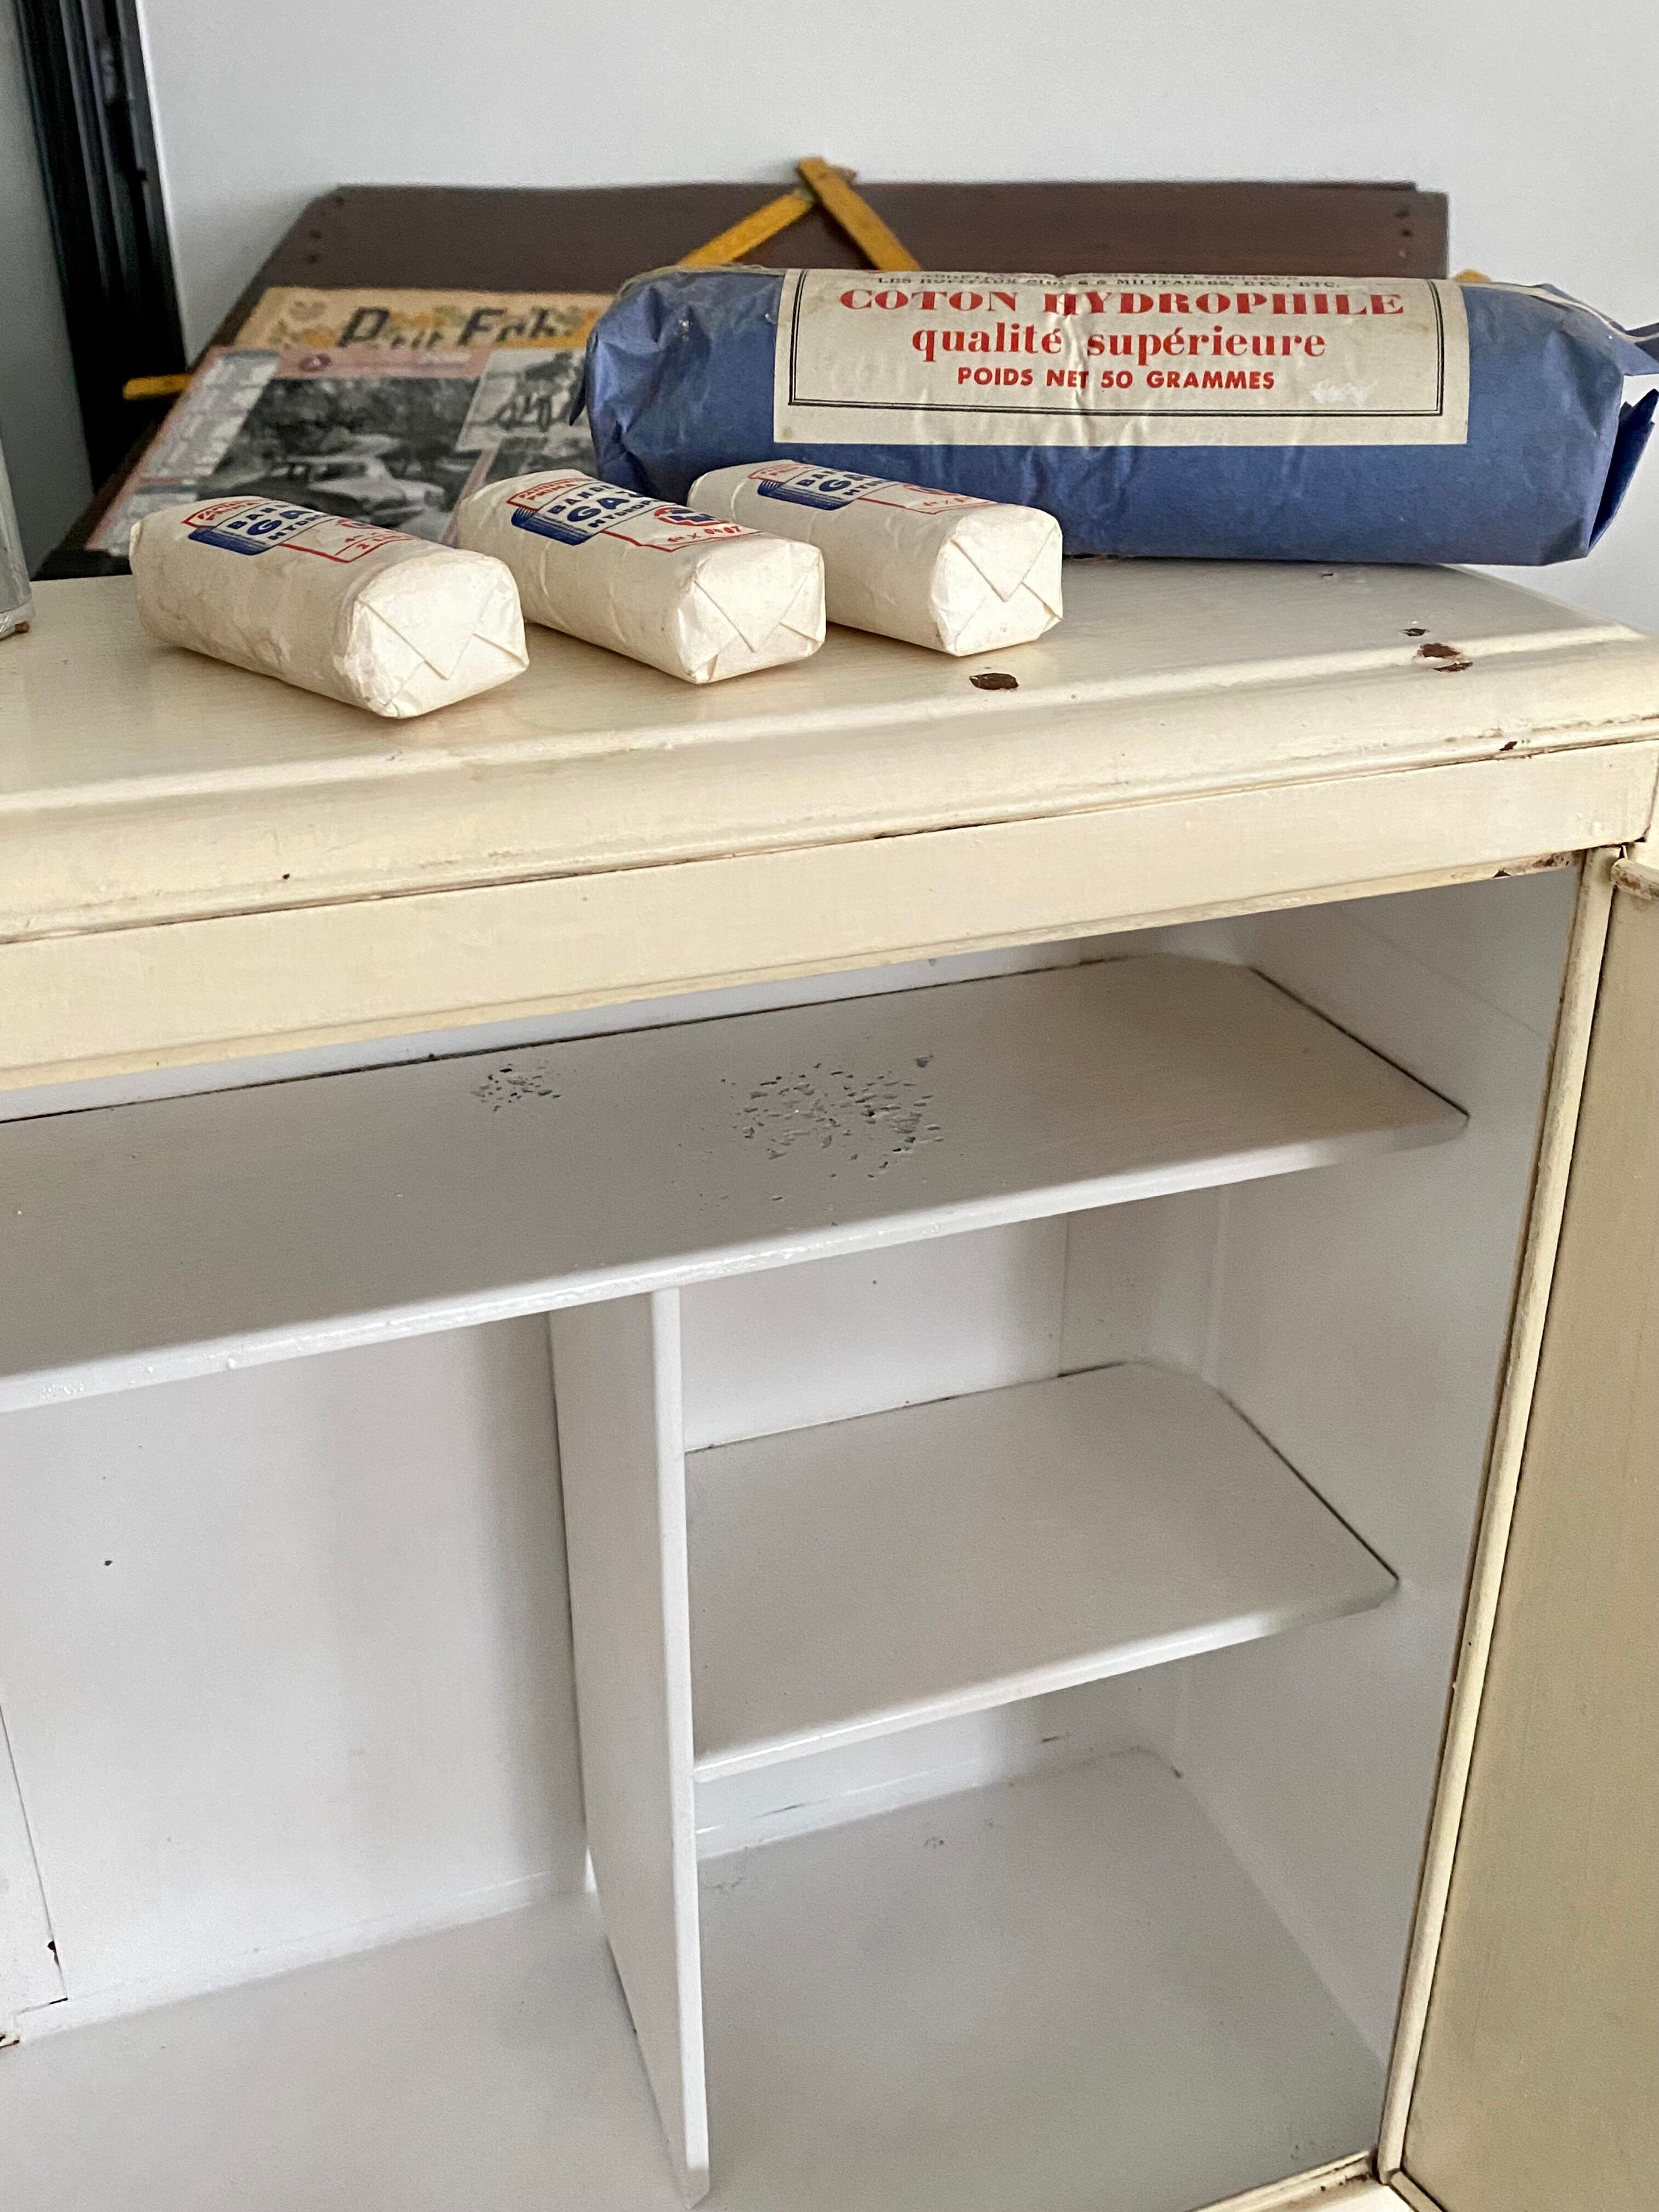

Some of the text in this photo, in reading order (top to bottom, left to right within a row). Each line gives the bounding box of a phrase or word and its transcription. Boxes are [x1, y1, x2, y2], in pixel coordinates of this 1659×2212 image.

[839, 289, 1404, 316] COTON HYDROPHILE
[911, 321, 1327, 367] qualité supérieure
[957, 366, 1275, 390] POIDS NET 50 GRAMMES
[588, 500, 657, 528] HYDROP
